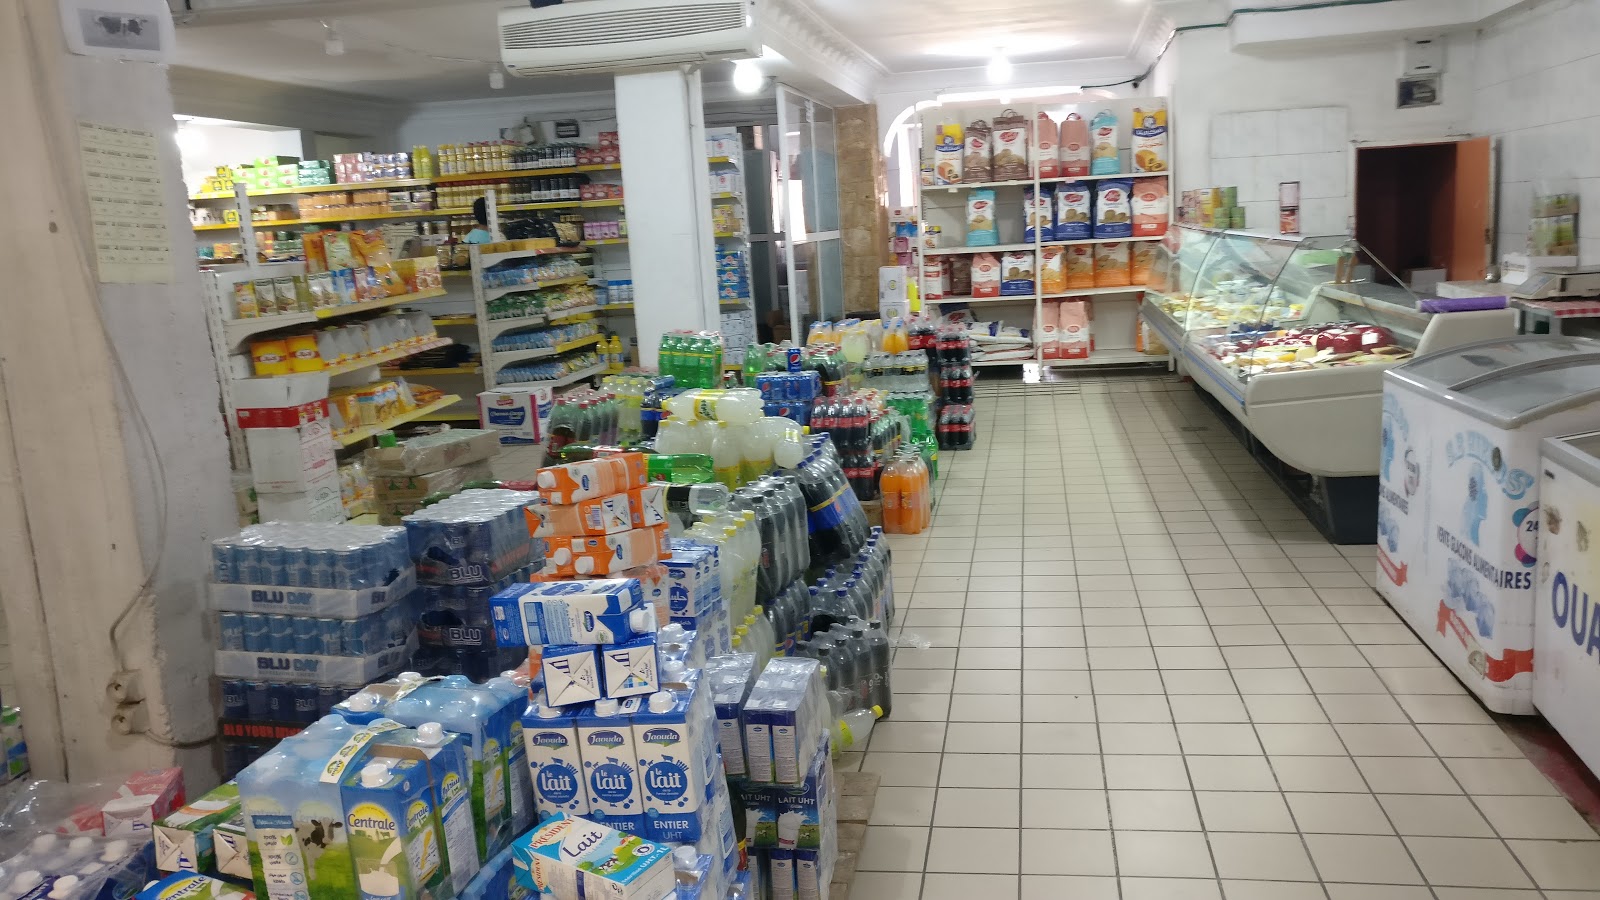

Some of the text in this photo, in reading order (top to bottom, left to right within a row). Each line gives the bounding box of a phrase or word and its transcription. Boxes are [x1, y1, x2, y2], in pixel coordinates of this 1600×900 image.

[450, 565, 482, 580] BLU
[251, 590, 314, 605] BLU DAY
[449, 628, 482, 642] BLU
[257, 657, 319, 672] BLU DAY
[535, 736, 566, 745] Jaouda
[590, 735, 622, 744] Jaouda
[646, 732, 678, 741] Jaouda
[546, 770, 553, 778] le
[601, 769, 608, 777] le
[650, 770, 682, 788] lait
[541, 773, 572, 791] lait
[595, 772, 627, 790] lait
[778, 796, 815, 805] LAIT UHT
[347, 813, 395, 831] Centrale
[654, 820, 689, 830] ENTIER
[662, 831, 683, 840] UHT
[562, 831, 603, 858] Lait
